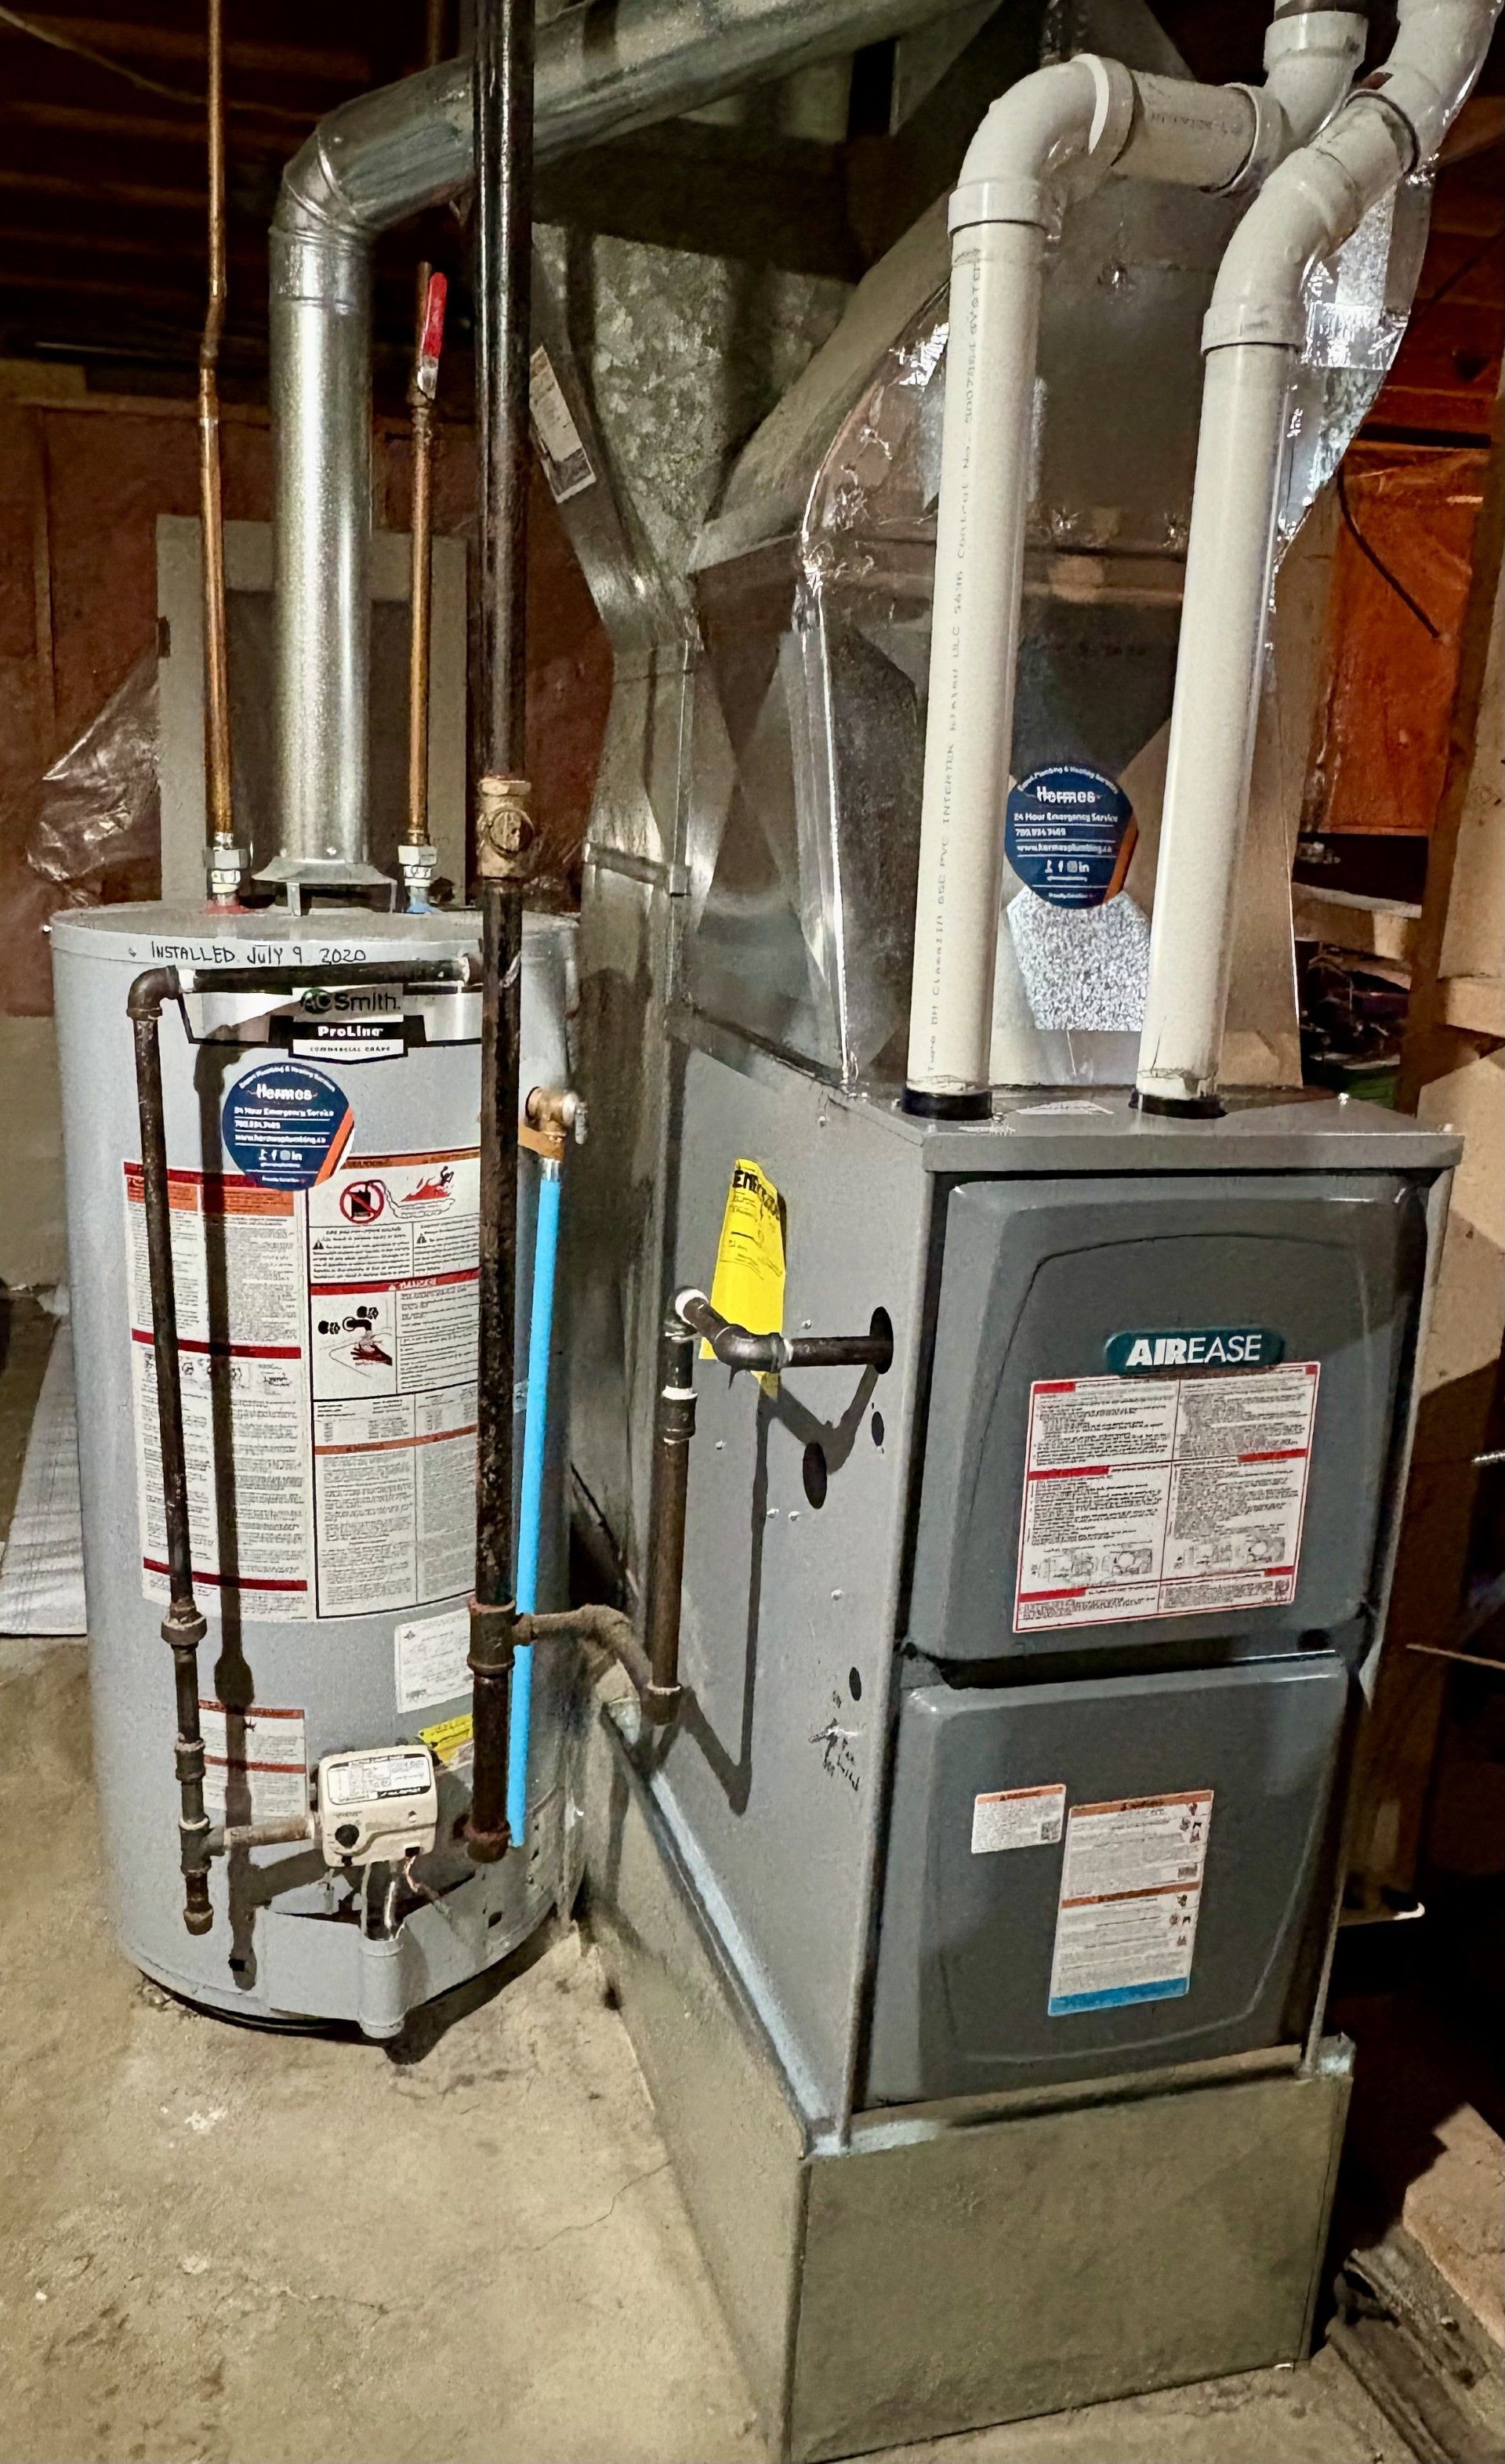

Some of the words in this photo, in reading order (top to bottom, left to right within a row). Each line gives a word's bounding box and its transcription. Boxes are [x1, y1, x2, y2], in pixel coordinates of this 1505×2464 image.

[151, 940, 236, 963] INSTALLED
[292, 946, 303, 964] 9
[318, 948, 367, 965] 2020
[1126, 1334, 1262, 1367] AIREASE
